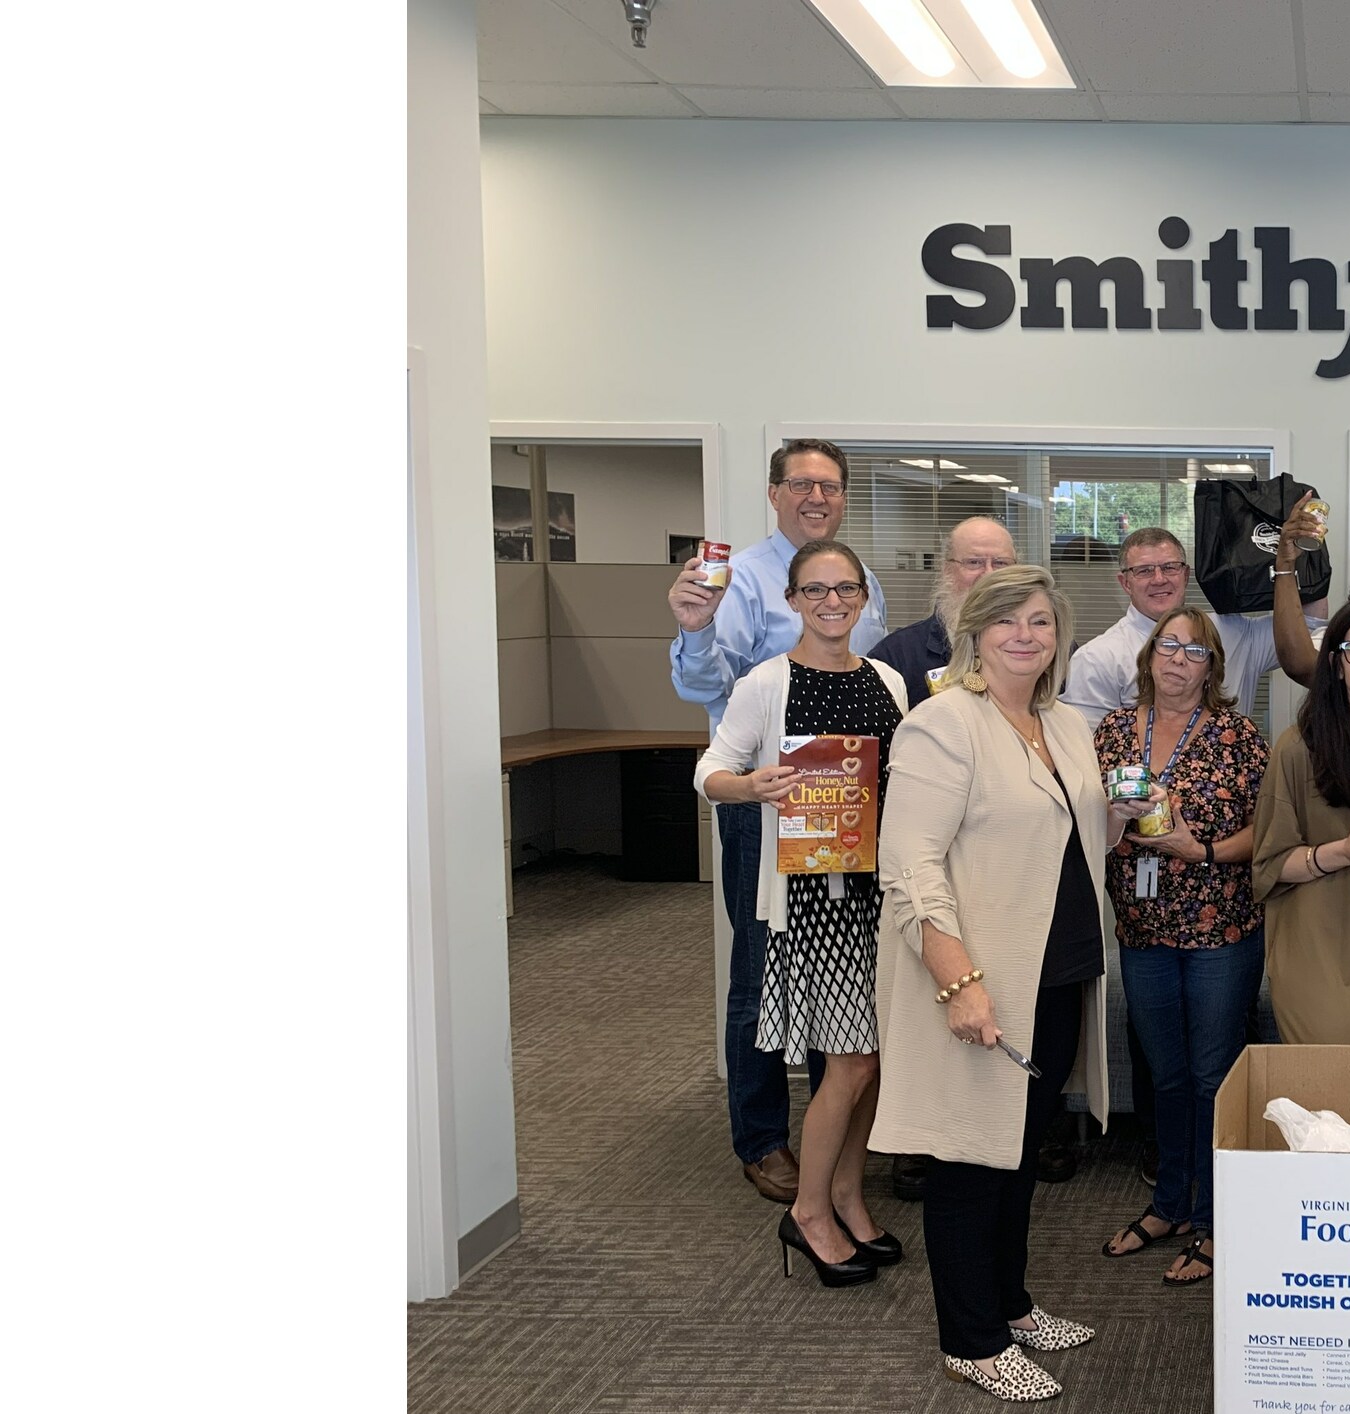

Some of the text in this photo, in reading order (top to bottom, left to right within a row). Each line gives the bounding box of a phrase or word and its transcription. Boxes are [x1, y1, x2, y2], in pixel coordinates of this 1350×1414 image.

[816, 776, 858, 787] Honey Nut
[1247, 1292, 1335, 1309] NOURISH
[1248, 1334, 1285, 1346] MOST
[1289, 1336, 1343, 1348] NEEDED
[1253, 1398, 1292, 1410] Thank
[1295, 1402, 1316, 1414] you
[1319, 1400, 1336, 1414] for
